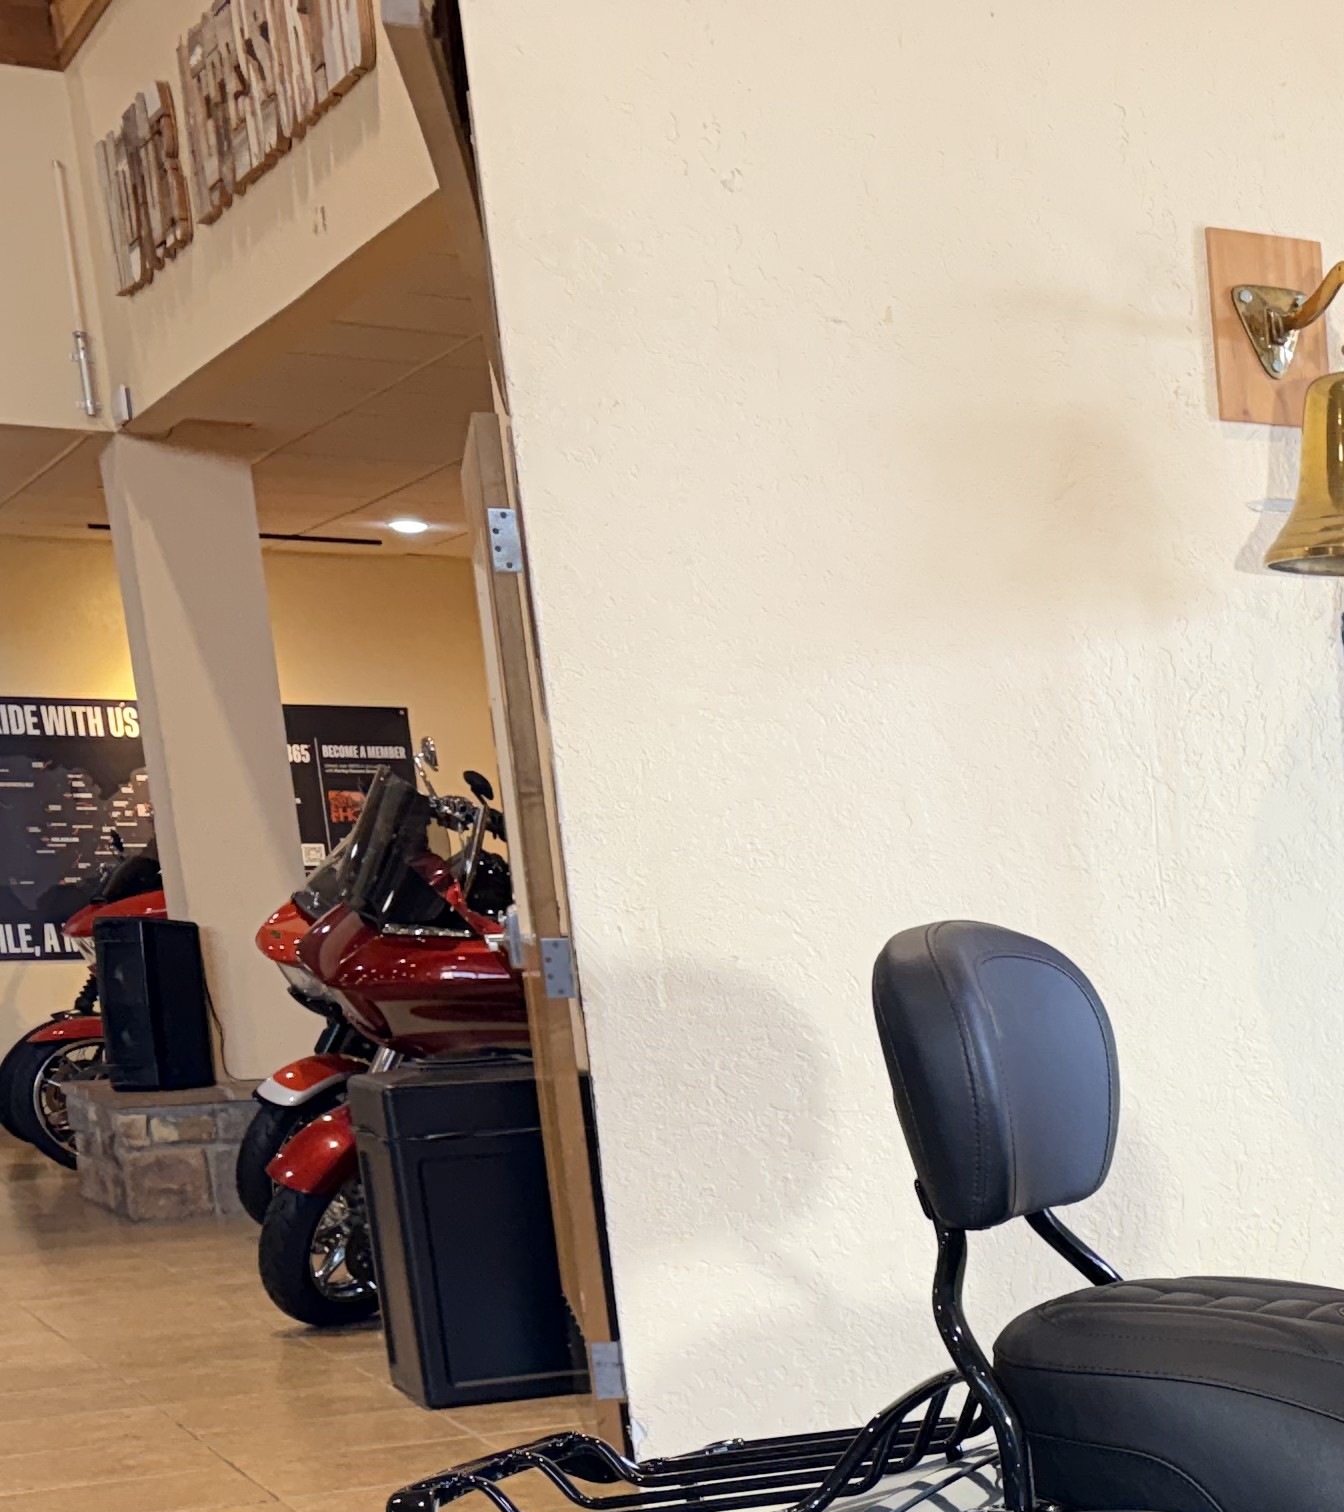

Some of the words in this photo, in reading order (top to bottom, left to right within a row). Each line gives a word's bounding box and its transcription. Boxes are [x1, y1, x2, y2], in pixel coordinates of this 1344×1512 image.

[0, 704, 40, 736] IDE
[40, 705, 105, 737] WITH
[107, 706, 140, 738] US
[322, 745, 359, 758] BECOME
[360, 746, 367, 758] A
[367, 746, 406, 759] MEMBER
[44, 923, 61, 953] A
